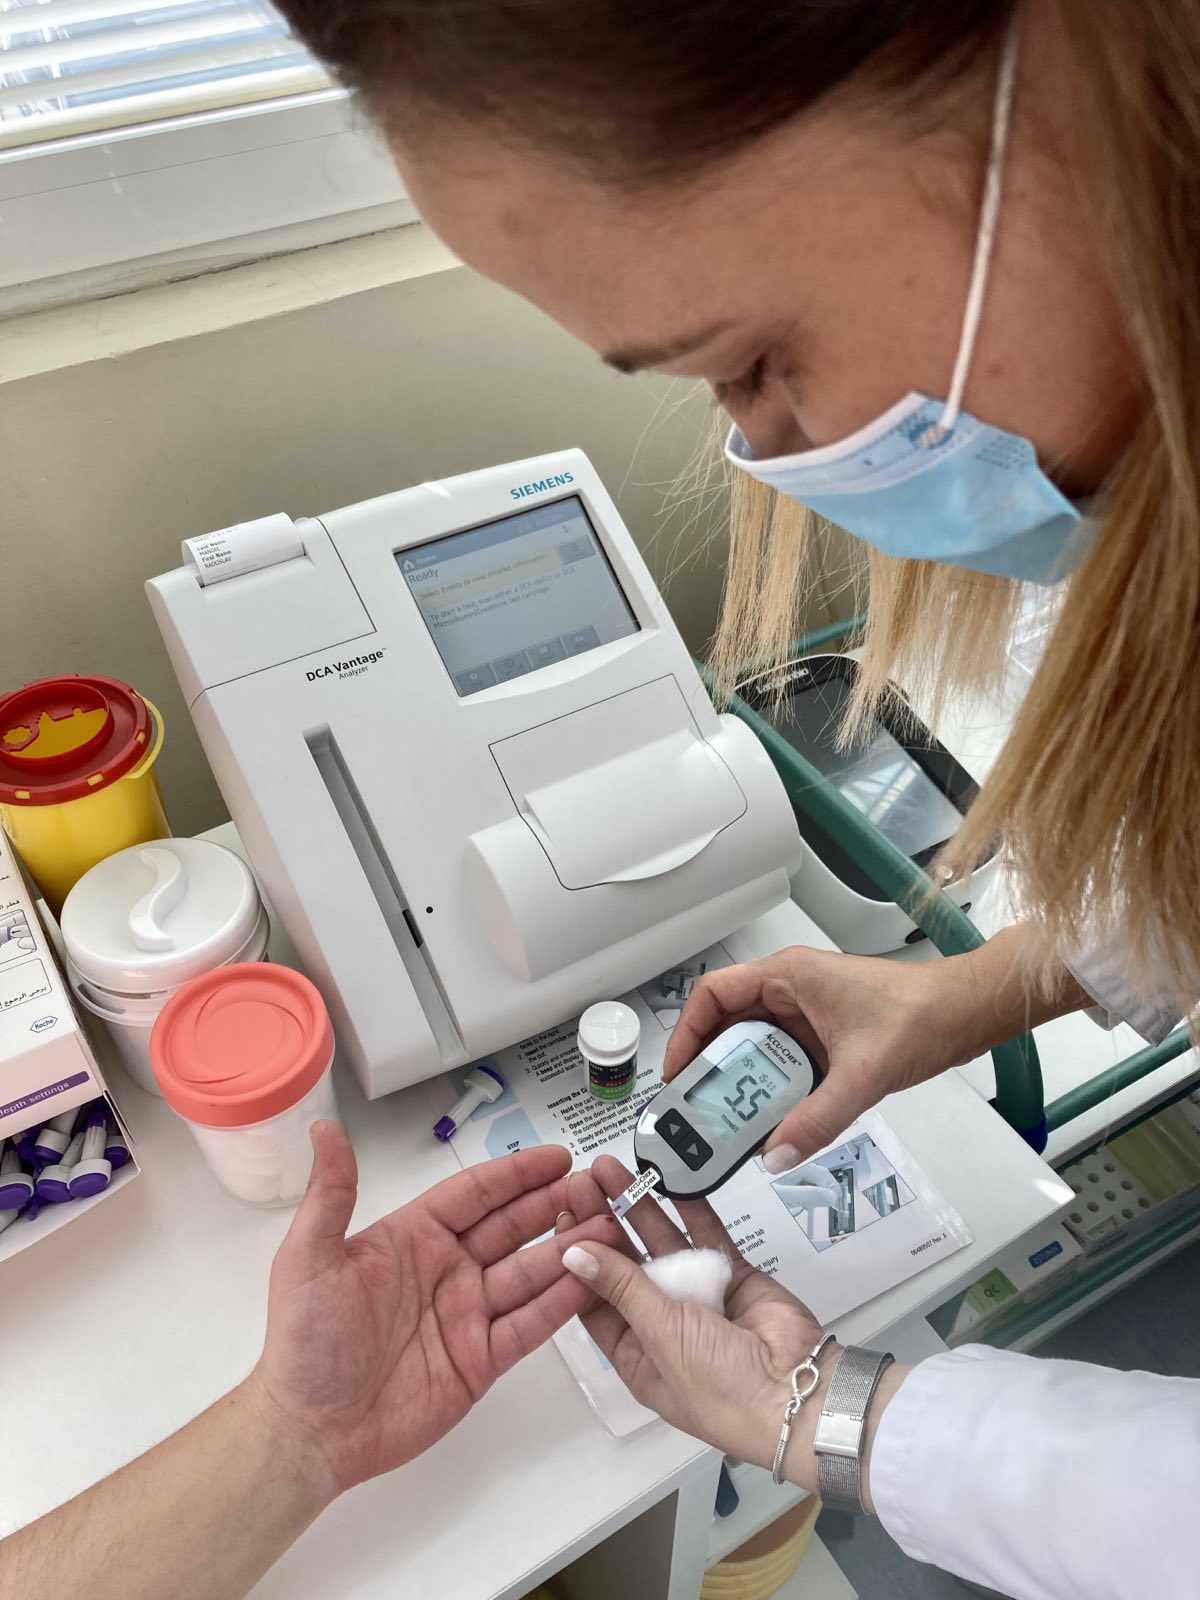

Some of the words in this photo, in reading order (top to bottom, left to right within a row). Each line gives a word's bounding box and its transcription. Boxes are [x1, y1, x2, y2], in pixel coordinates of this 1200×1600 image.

[510, 472, 574, 500] SIEMENS
[216, 550, 232, 558] Name
[408, 568, 438, 584] Ready
[430, 614, 439, 622] To
[306, 666, 333, 682] DCA
[338, 665, 369, 680] Analyzer
[34, 1019, 54, 1030] Roche
[549, 1054, 560, 1062] and
[764, 1042, 787, 1065] Performa
[540, 1065, 554, 1075] beep
[553, 1061, 563, 1069] and
[29, 1082, 70, 1102] settings
[547, 1095, 572, 1110] Inserting
[572, 1089, 581, 1098] the
[560, 1106, 574, 1115] Hold
[574, 1101, 583, 1110] the
[637, 1069, 654, 1079] arcode
[564, 1111, 579, 1122] faces
[585, 1104, 594, 1112] the
[569, 1120, 584, 1130] Open
[584, 1114, 593, 1122] the
[593, 1109, 606, 1118] door
[606, 1104, 617, 1112] and
[632, 1091, 641, 1099] the
[641, 1082, 664, 1096] cartridge
[573, 1129, 582, 1137] the
[583, 1112, 616, 1132] compartment
[616, 1107, 629, 1116] until
[633, 1098, 646, 1108] click
[577, 1133, 595, 1145] Slowly
[594, 1129, 605, 1138] and
[603, 1122, 618, 1133] firmly
[618, 1116, 628, 1126] pull
[507, 1140, 520, 1150] STEP
[582, 1142, 599, 1153] Close
[598, 1136, 608, 1145] the
[608, 1131, 621, 1141] door
[628, 1169, 653, 1195] ACCU-CHEK
[632, 1174, 657, 1201] ACCU-CHEK
[733, 1219, 742, 1227] on
[741, 1213, 752, 1222] the
[735, 1238, 746, 1248] ush
[745, 1233, 756, 1241] the
[755, 1228, 765, 1236] tab
[745, 1238, 767, 1252] unlock.
[762, 1256, 779, 1268] injury
